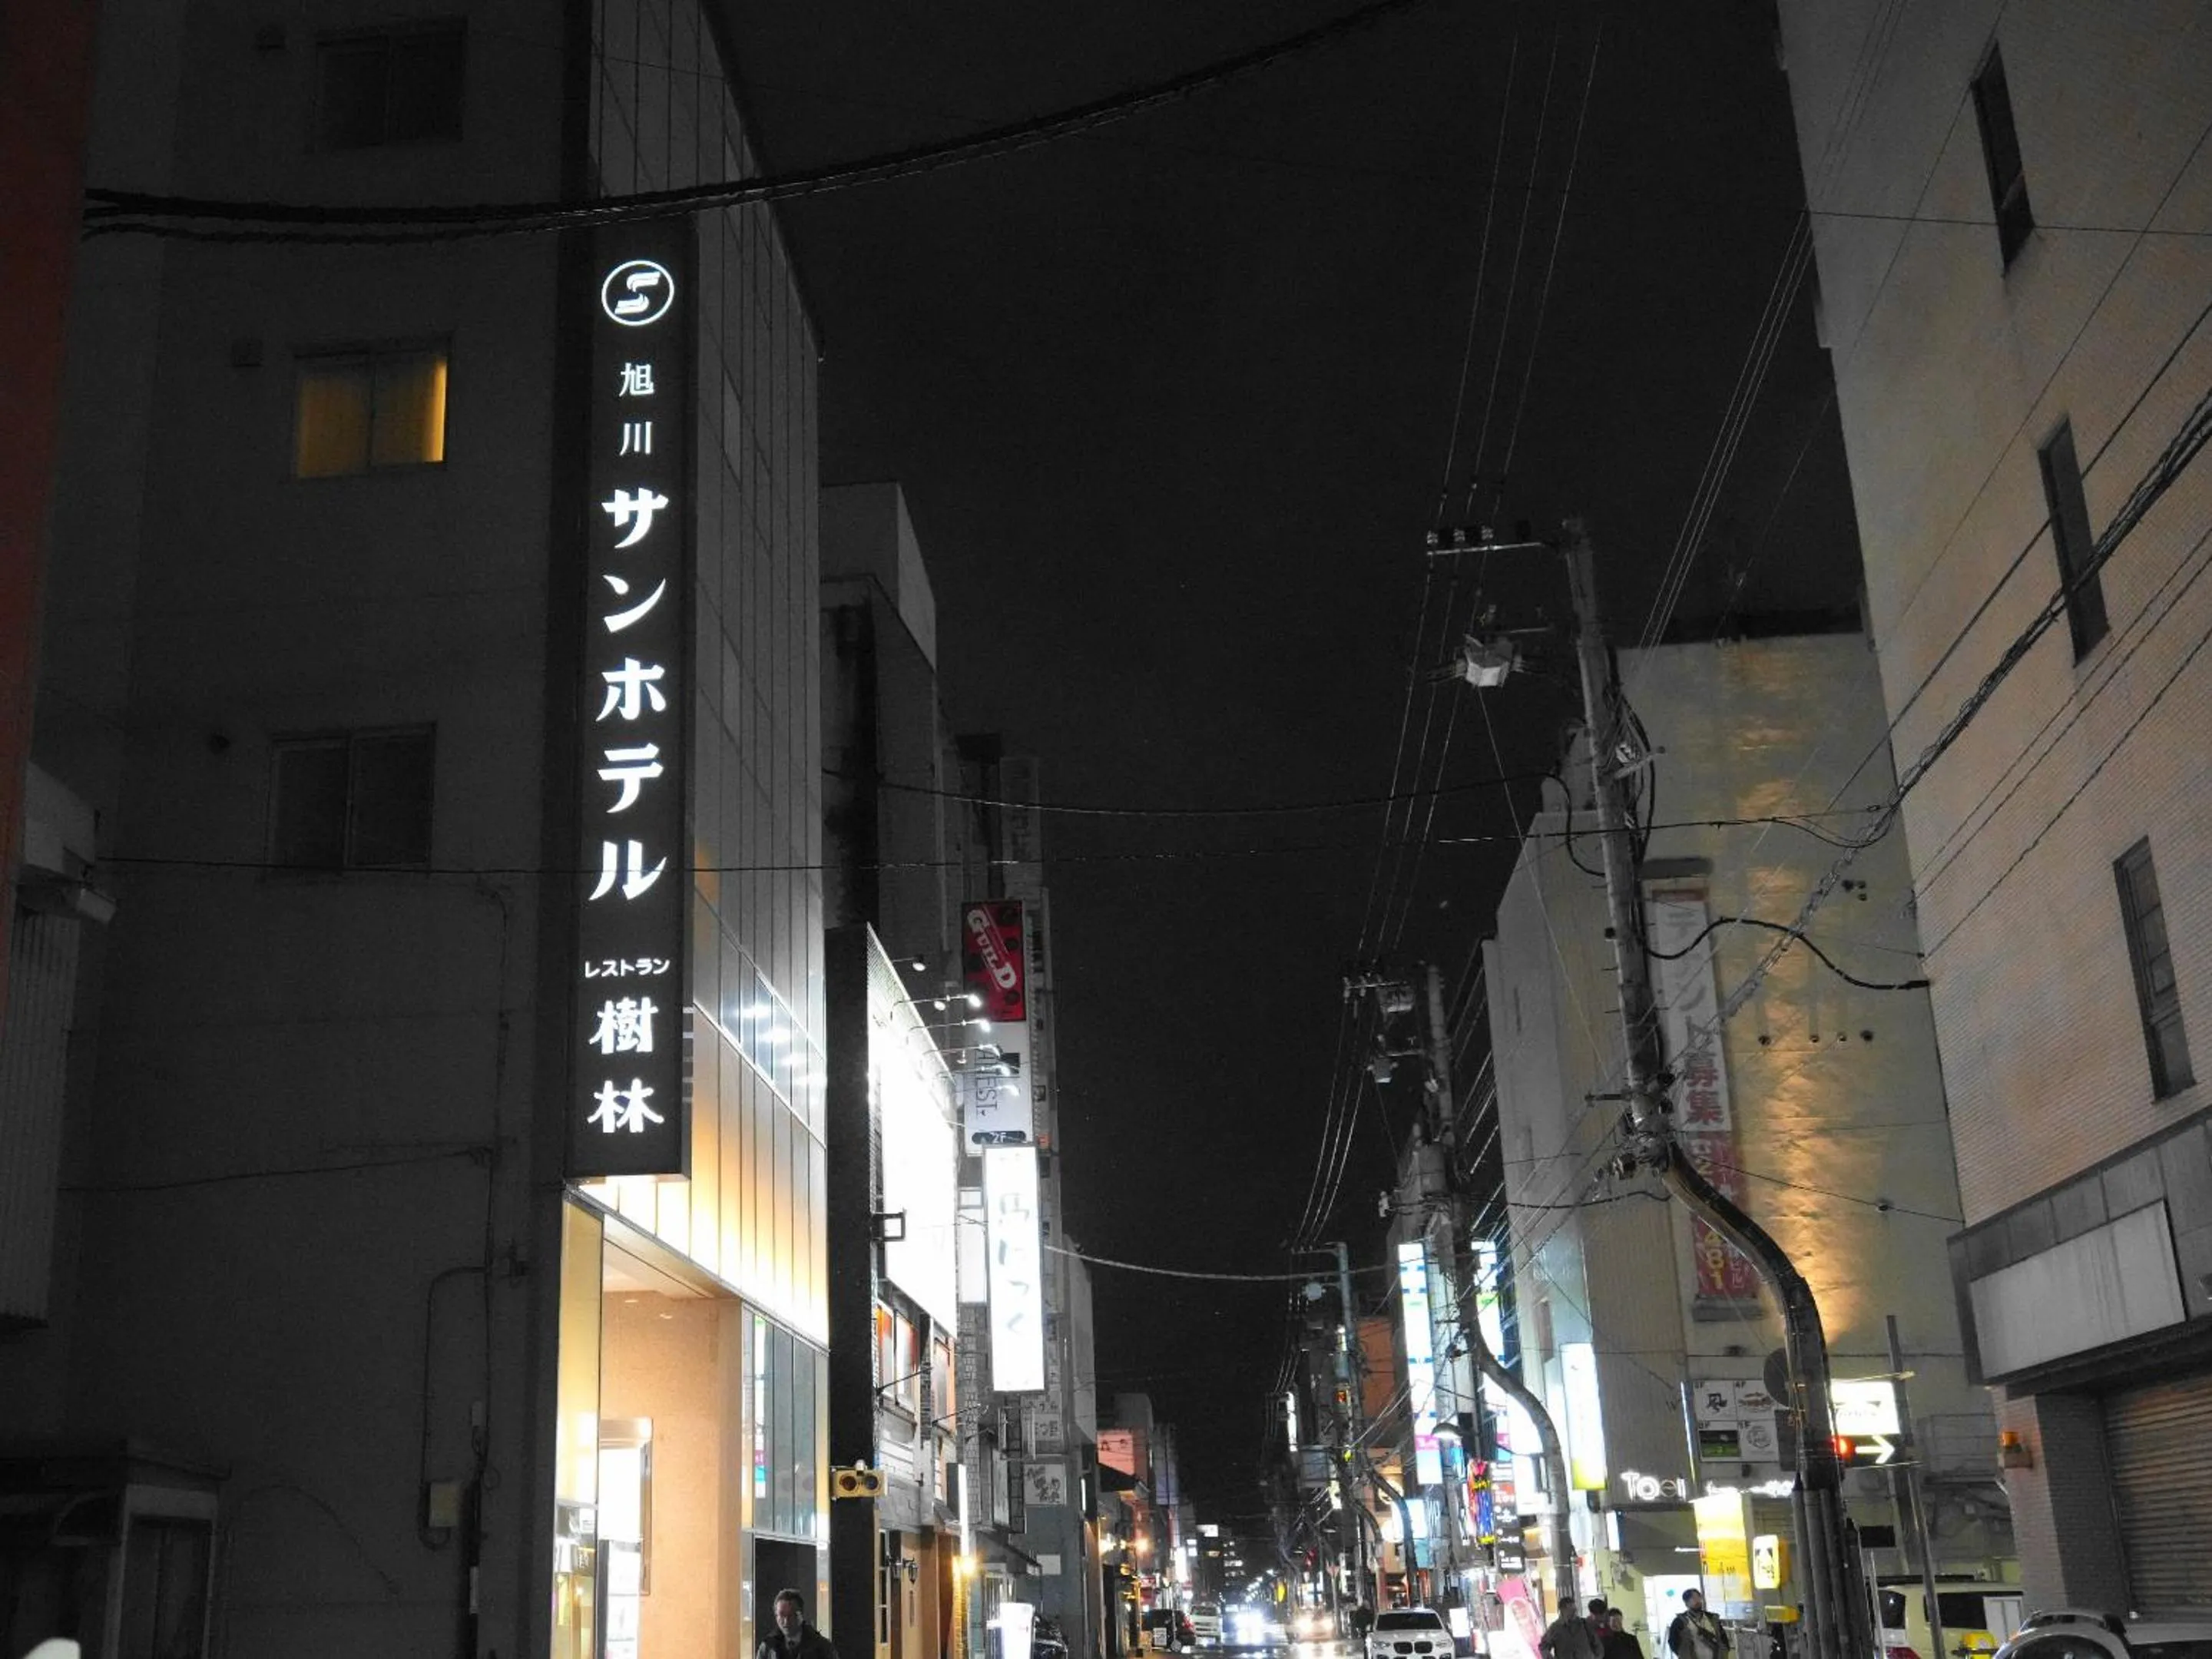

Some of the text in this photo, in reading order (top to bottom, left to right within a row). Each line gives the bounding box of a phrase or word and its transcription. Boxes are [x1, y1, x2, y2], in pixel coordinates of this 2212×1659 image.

[589, 362, 669, 901] 旭川サンホテル
[584, 959, 670, 978] レストラン
[587, 997, 664, 1134] 樹林
